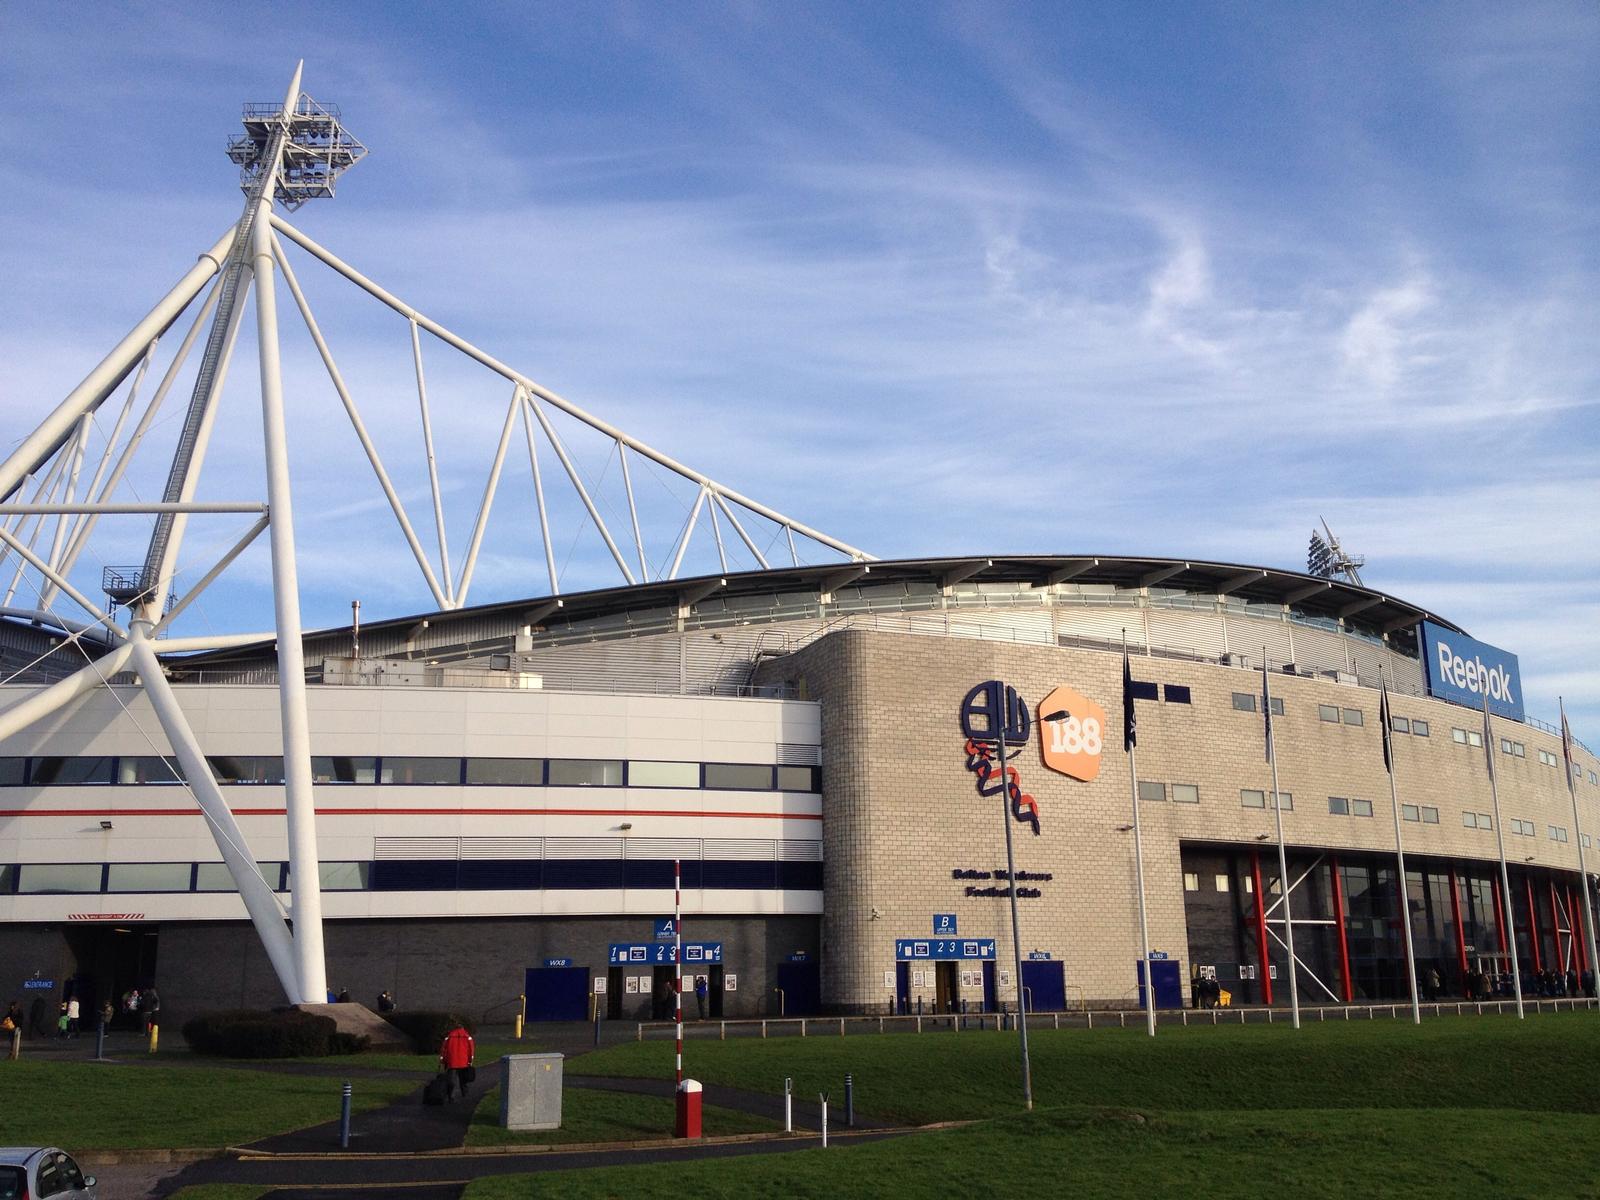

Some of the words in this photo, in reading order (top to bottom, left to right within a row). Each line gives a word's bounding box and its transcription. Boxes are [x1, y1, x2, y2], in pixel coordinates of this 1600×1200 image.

[1437, 641, 1514, 704] Reebok
[1049, 716, 1102, 755] 188
[1016, 887, 1041, 898] Club
[663, 920, 673, 931] A
[941, 916, 949, 928] B
[610, 946, 617, 957] 1
[657, 945, 665, 957] 2
[669, 945, 677, 957] 3
[713, 944, 721, 956] 4
[898, 942, 903, 953] 1
[938, 942, 944, 952] 2
[949, 941, 956, 952] 3
[987, 941, 994, 952] 4
